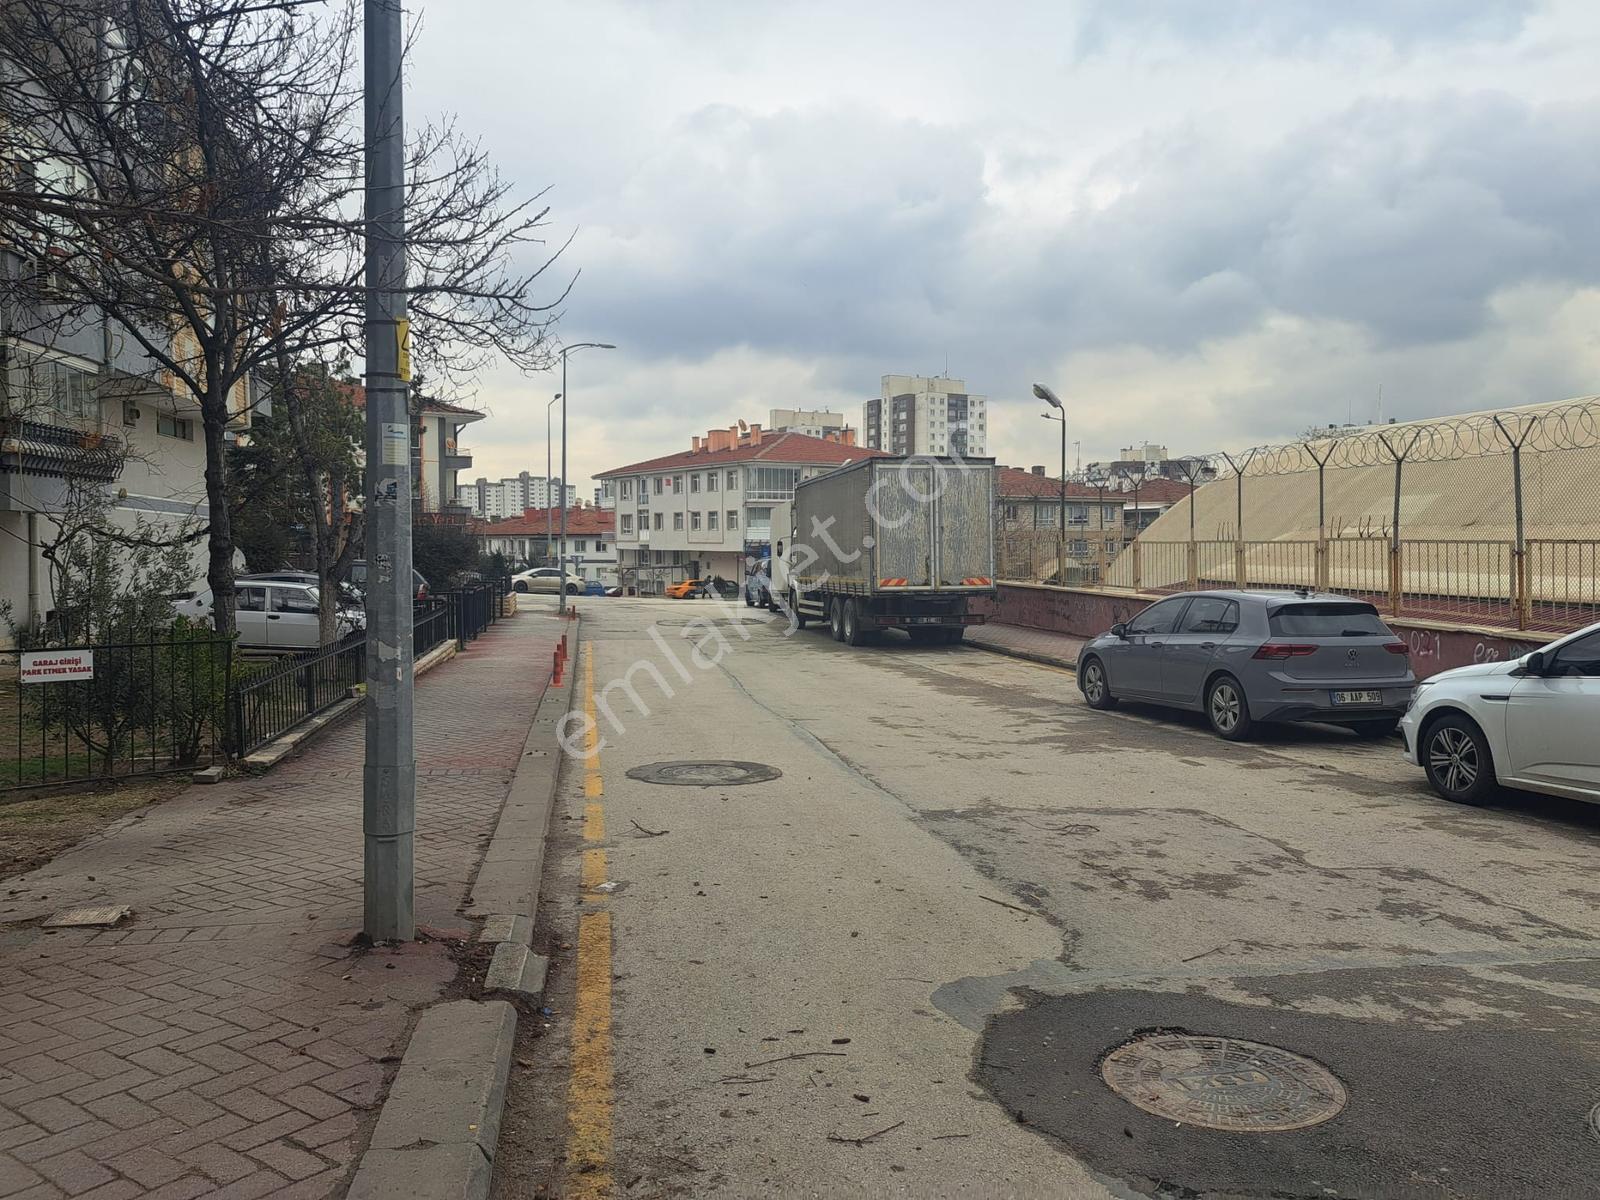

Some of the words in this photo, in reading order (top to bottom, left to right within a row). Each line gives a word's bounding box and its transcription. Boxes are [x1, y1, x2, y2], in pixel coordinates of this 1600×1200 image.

[32, 659, 58, 667] GARAJ
[59, 657, 82, 666] GİRİŞİ
[22, 668, 42, 676] PARK
[43, 667, 67, 675] ETMEK
[1350, 692, 1363, 702] AAP
